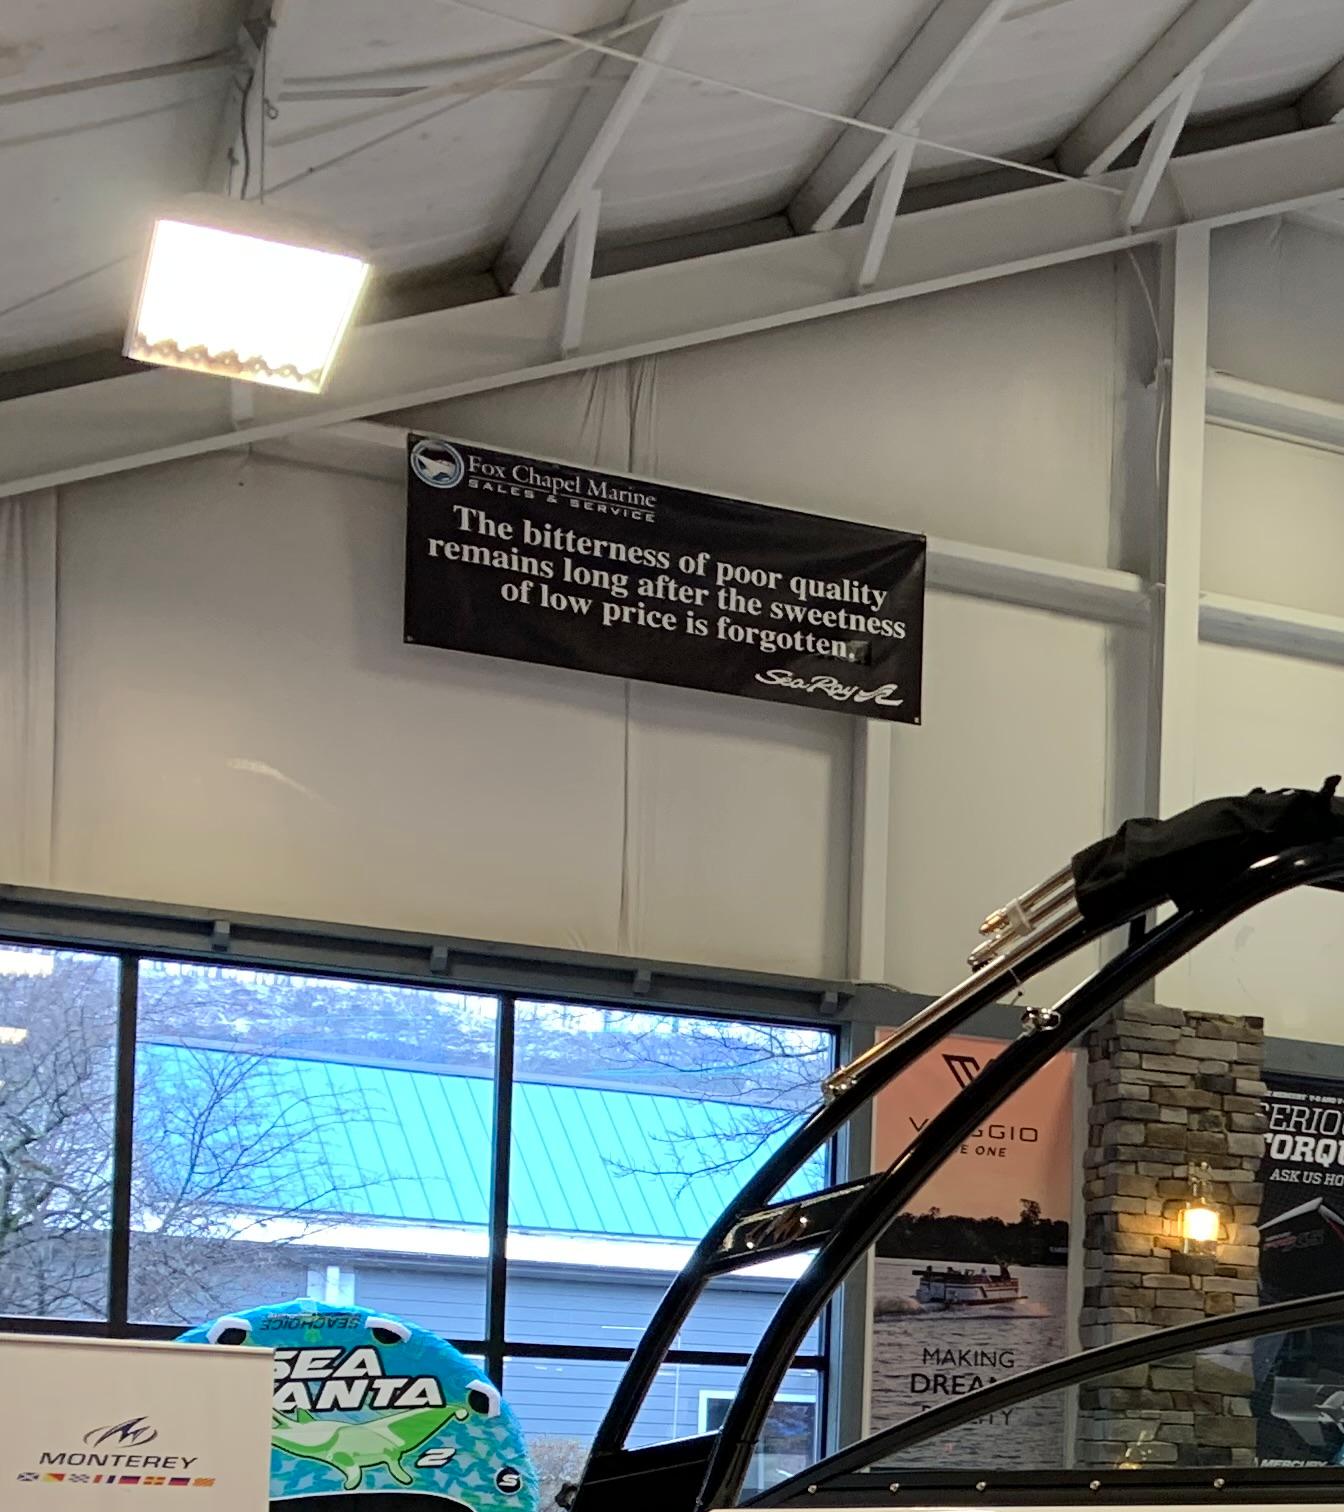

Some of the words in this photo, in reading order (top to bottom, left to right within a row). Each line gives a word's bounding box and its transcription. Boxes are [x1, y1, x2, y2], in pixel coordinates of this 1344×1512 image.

[467, 455, 505, 478] Fox
[512, 465, 581, 495] Chapel
[587, 479, 657, 507] Marine
[468, 479, 535, 499] SALES
[546, 495, 559, 503] &
[569, 499, 656, 523] SERVICE
[452, 505, 514, 540] The
[523, 519, 670, 570] bitterness
[678, 552, 711, 577] of
[716, 561, 783, 589] poor
[789, 576, 888, 611] quality
[427, 538, 554, 578] remains
[563, 557, 629, 598] long
[637, 574, 710, 606] after
[717, 588, 762, 616] the
[770, 601, 906, 639] sweetness
[501, 580, 533, 604] of
[540, 583, 593, 615] low
[602, 601, 678, 631] price
[686, 610, 709, 636] is
[716, 616, 856, 660] forgotten.
[909, 1116, 1038, 1143] VGIO
[975, 1145, 1007, 1158] ONE
[1269, 1168, 1301, 1183] ASK
[1302, 1172, 1322, 1185] US
[260, 1316, 361, 1331] SEACHOICE
[274, 1348, 382, 1379] SEA
[922, 1347, 1015, 1368] MAKING
[273, 1377, 443, 1408] ANTA
[39, 1452, 198, 1470] MONTEREY
[416, 1449, 455, 1467] 2
